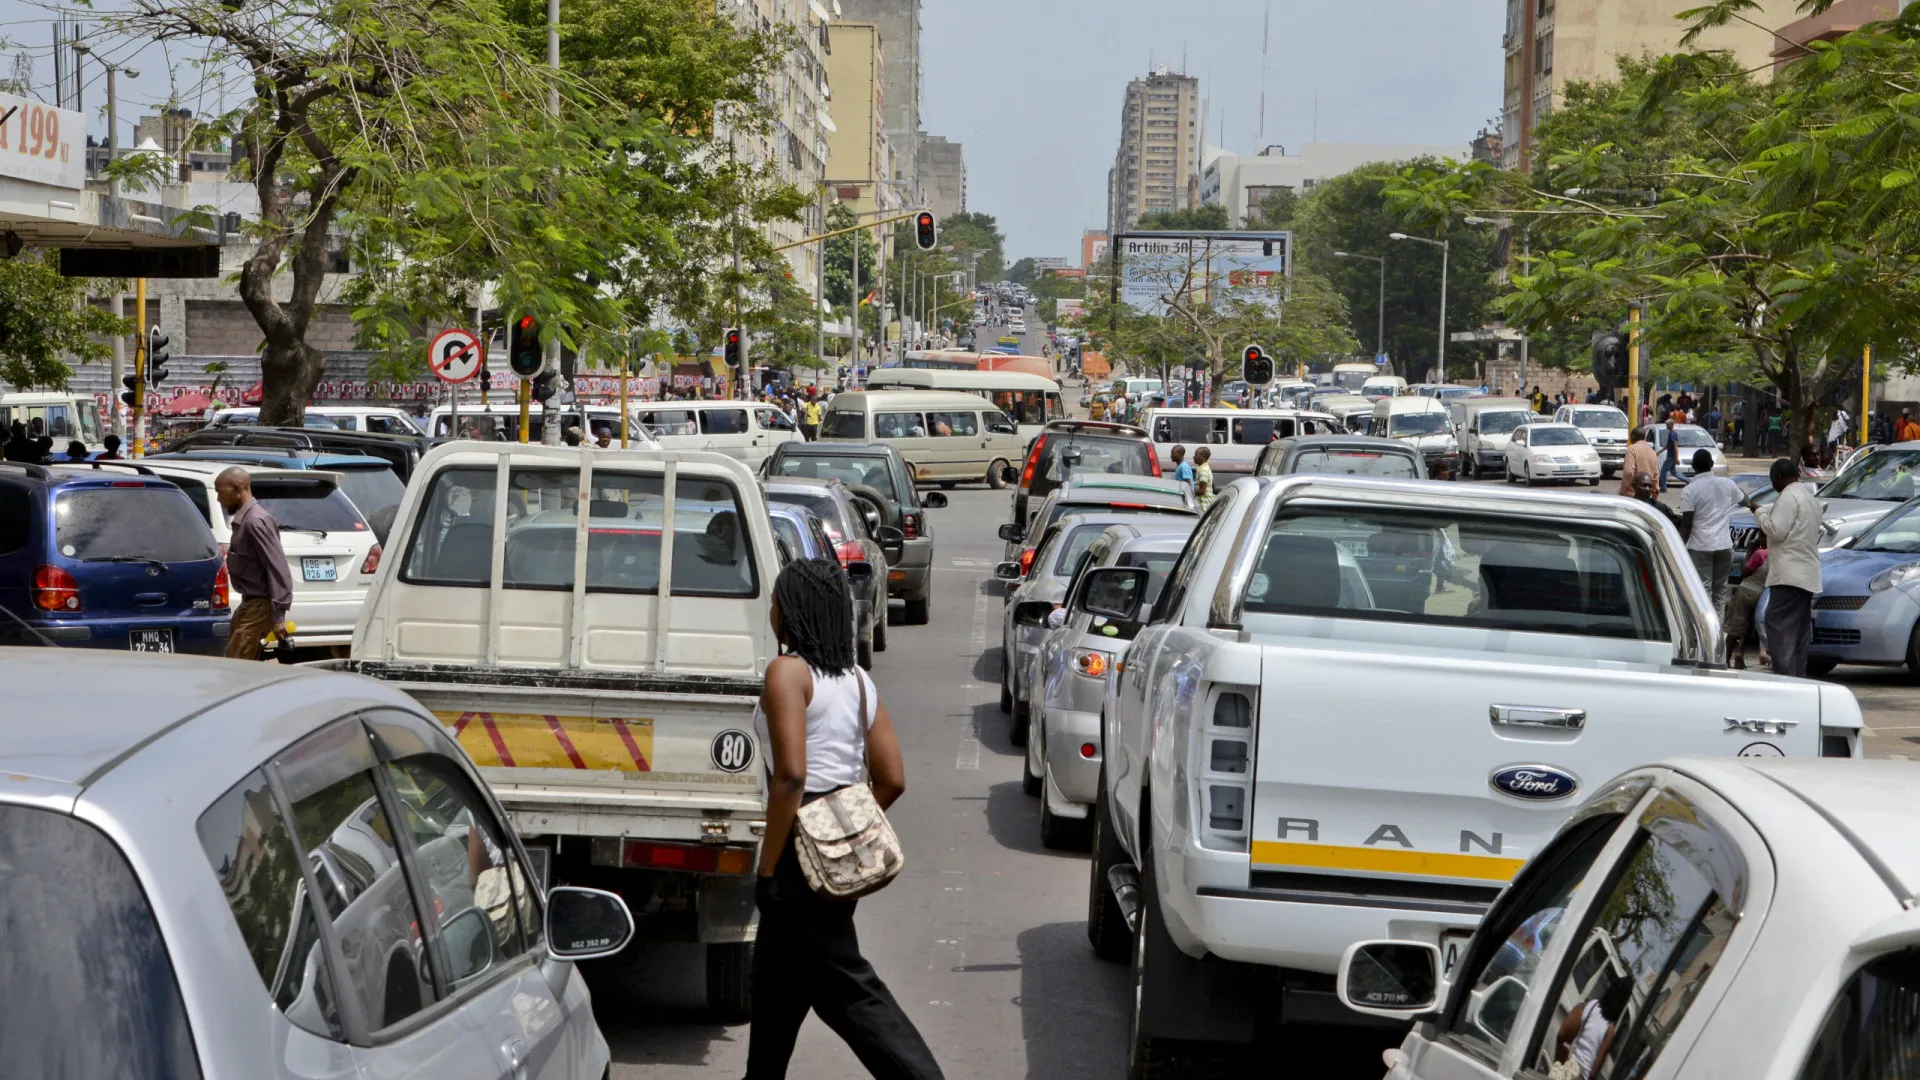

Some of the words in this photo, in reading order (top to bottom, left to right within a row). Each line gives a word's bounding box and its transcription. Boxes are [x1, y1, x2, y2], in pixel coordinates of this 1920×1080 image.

[18, 103, 60, 160] 199
[306, 569, 321, 578] 926
[325, 570, 335, 578] MP
[142, 631, 160, 643] MMQ
[721, 734, 745, 767] 80
[1509, 770, 1560, 793] Ford
